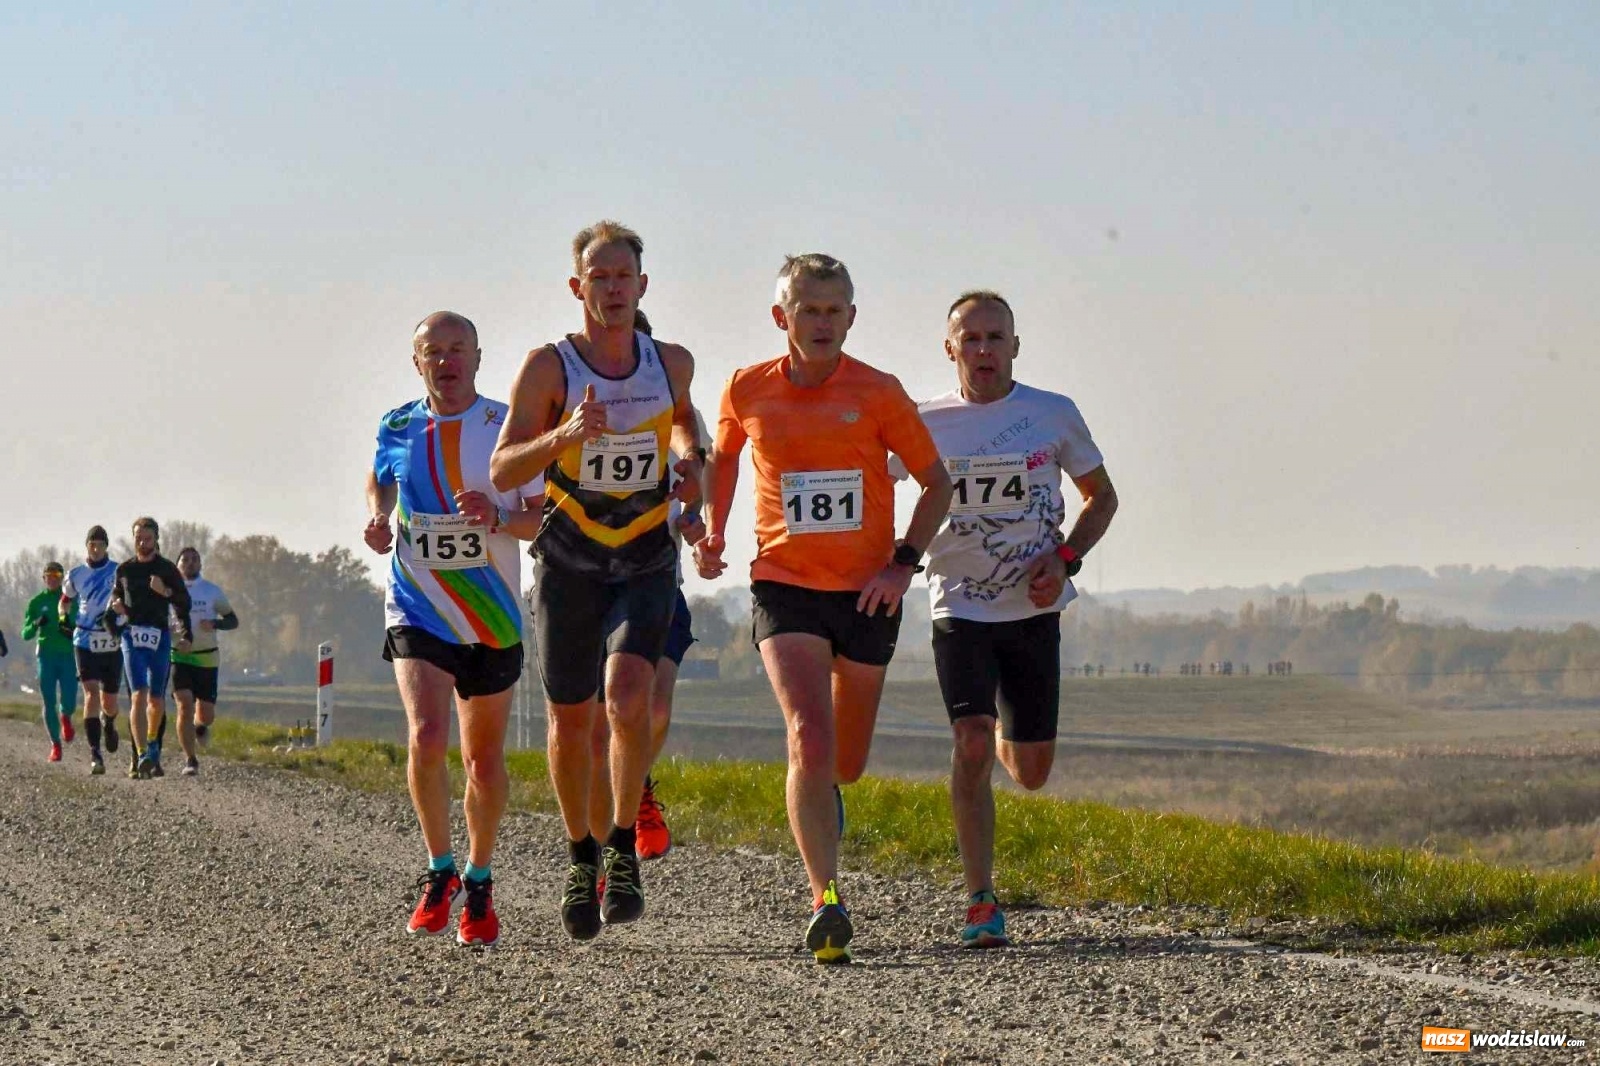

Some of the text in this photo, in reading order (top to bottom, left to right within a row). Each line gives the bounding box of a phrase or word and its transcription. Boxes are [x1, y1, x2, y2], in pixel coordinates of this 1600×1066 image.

[990, 416, 1034, 449] KIETRZ
[587, 452, 655, 482] 197
[953, 474, 1026, 505] 174
[787, 491, 854, 522] 181
[416, 532, 482, 560] 153
[92, 639, 117, 649] 173
[133, 633, 158, 646] 103
[320, 713, 329, 727] 7
